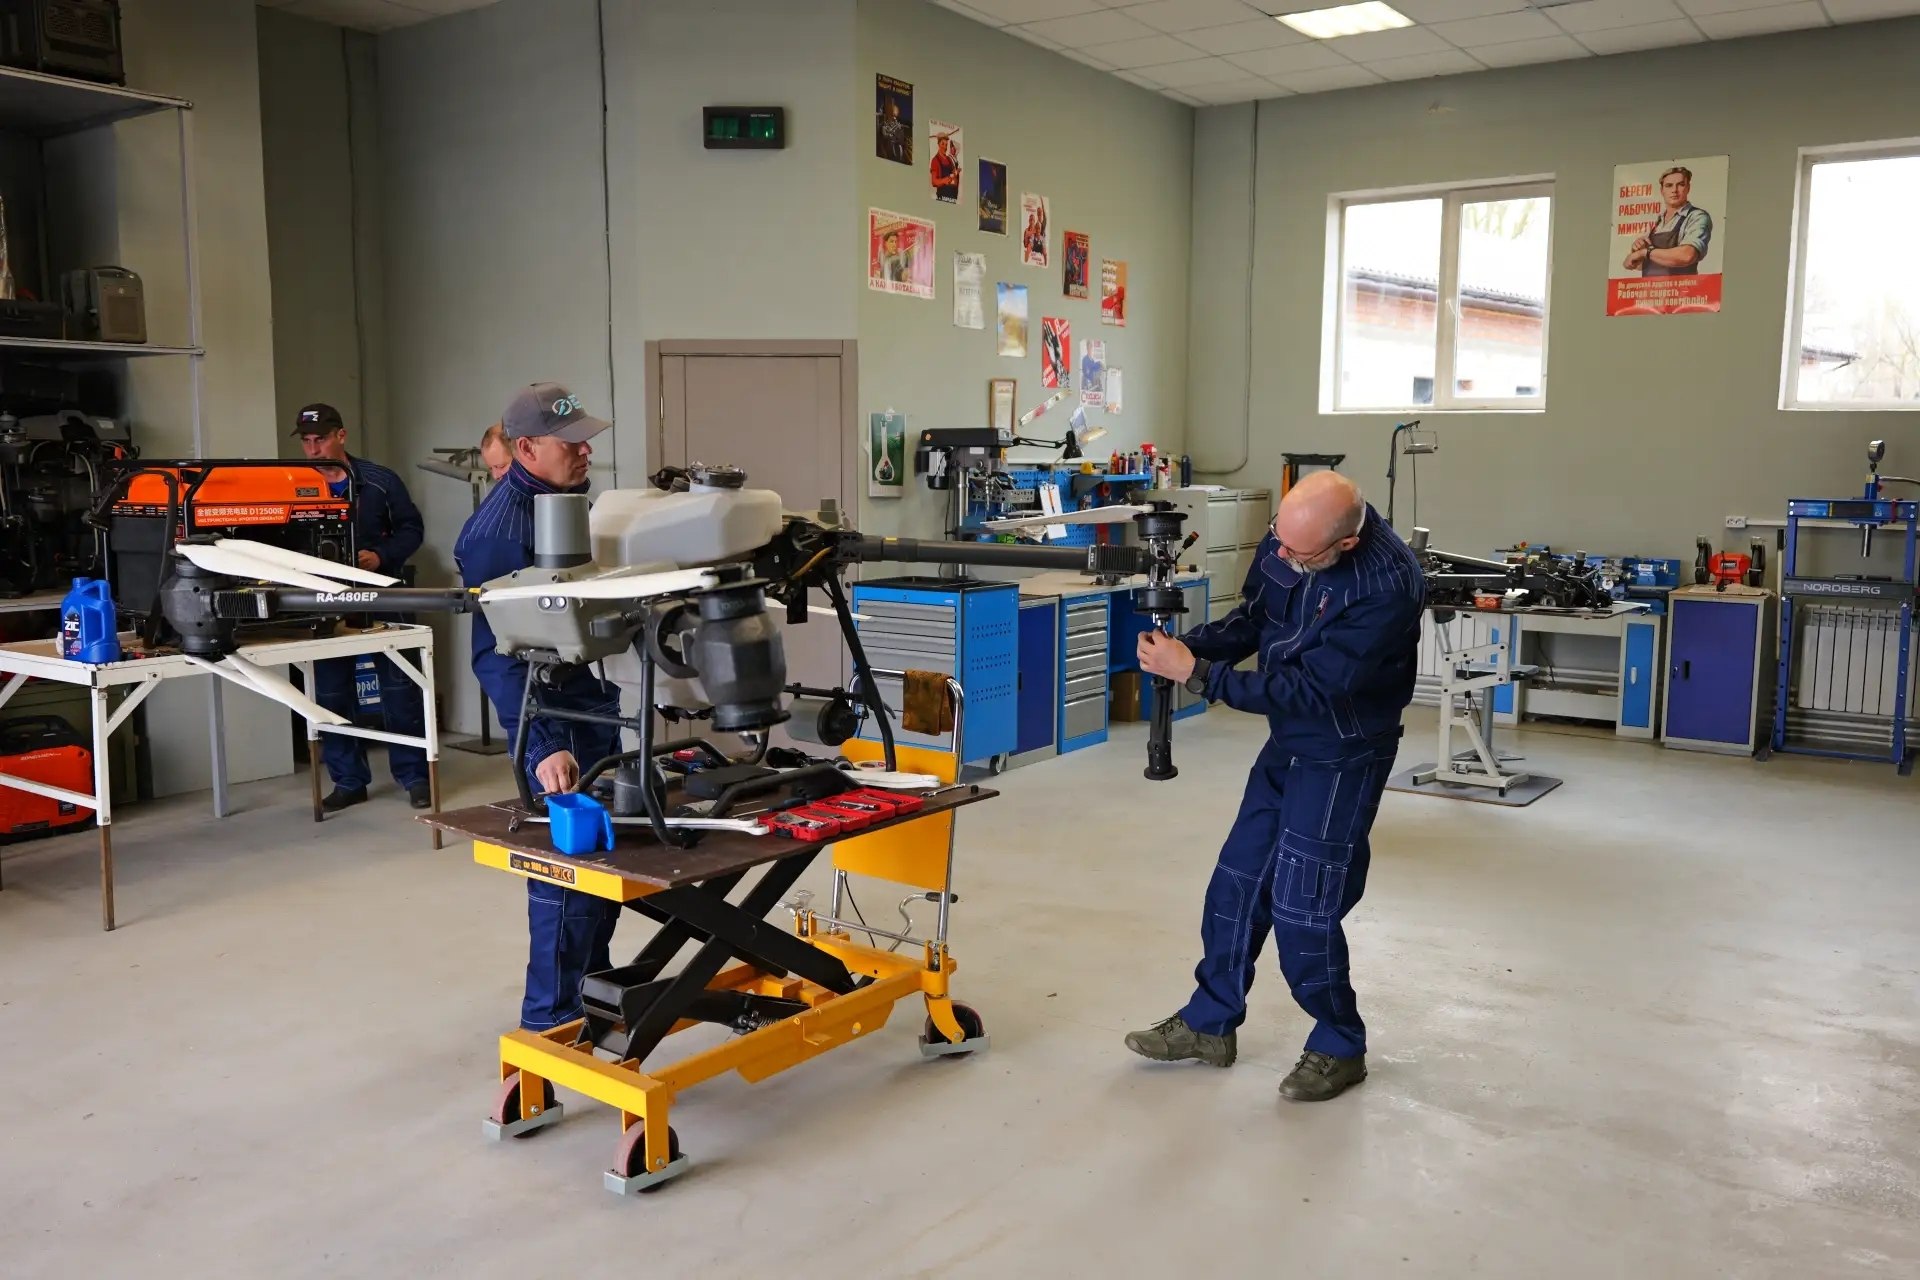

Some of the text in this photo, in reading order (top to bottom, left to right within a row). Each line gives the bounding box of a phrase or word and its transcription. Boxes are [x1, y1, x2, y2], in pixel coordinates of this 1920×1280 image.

[1620, 184, 1652, 198] БЕРЕГИ
[1619, 202, 1660, 216] РАБОЧУЮ
[1804, 584, 1880, 594] NORDBERG
[316, 592, 378, 602] RA-480EP
[64, 621, 80, 631] ZIC
